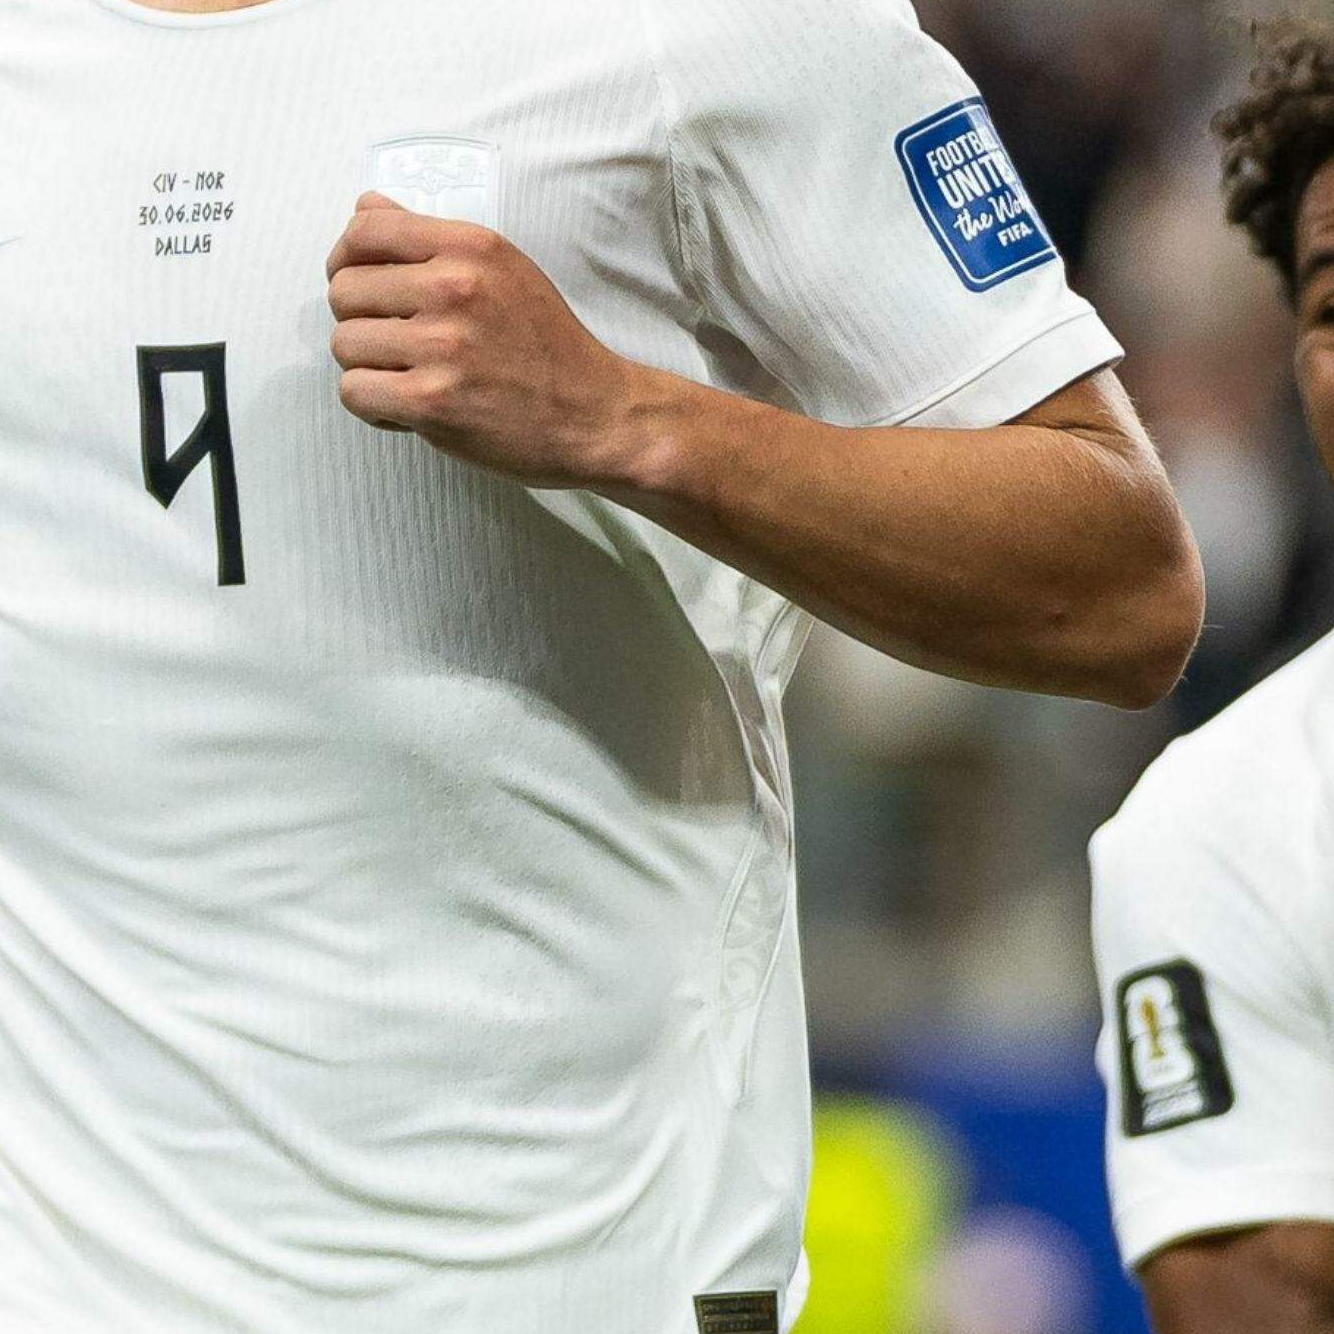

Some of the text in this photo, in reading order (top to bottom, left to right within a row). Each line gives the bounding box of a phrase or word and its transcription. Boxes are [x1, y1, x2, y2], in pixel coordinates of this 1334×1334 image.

[195, 171, 225, 191] NOR
[139, 202, 234, 225] 30.06.2026
[953, 208, 993, 241] the
[155, 234, 212, 256] DALLAS
[997, 221, 1034, 247] FIFA
[136, 341, 246, 586] 9
